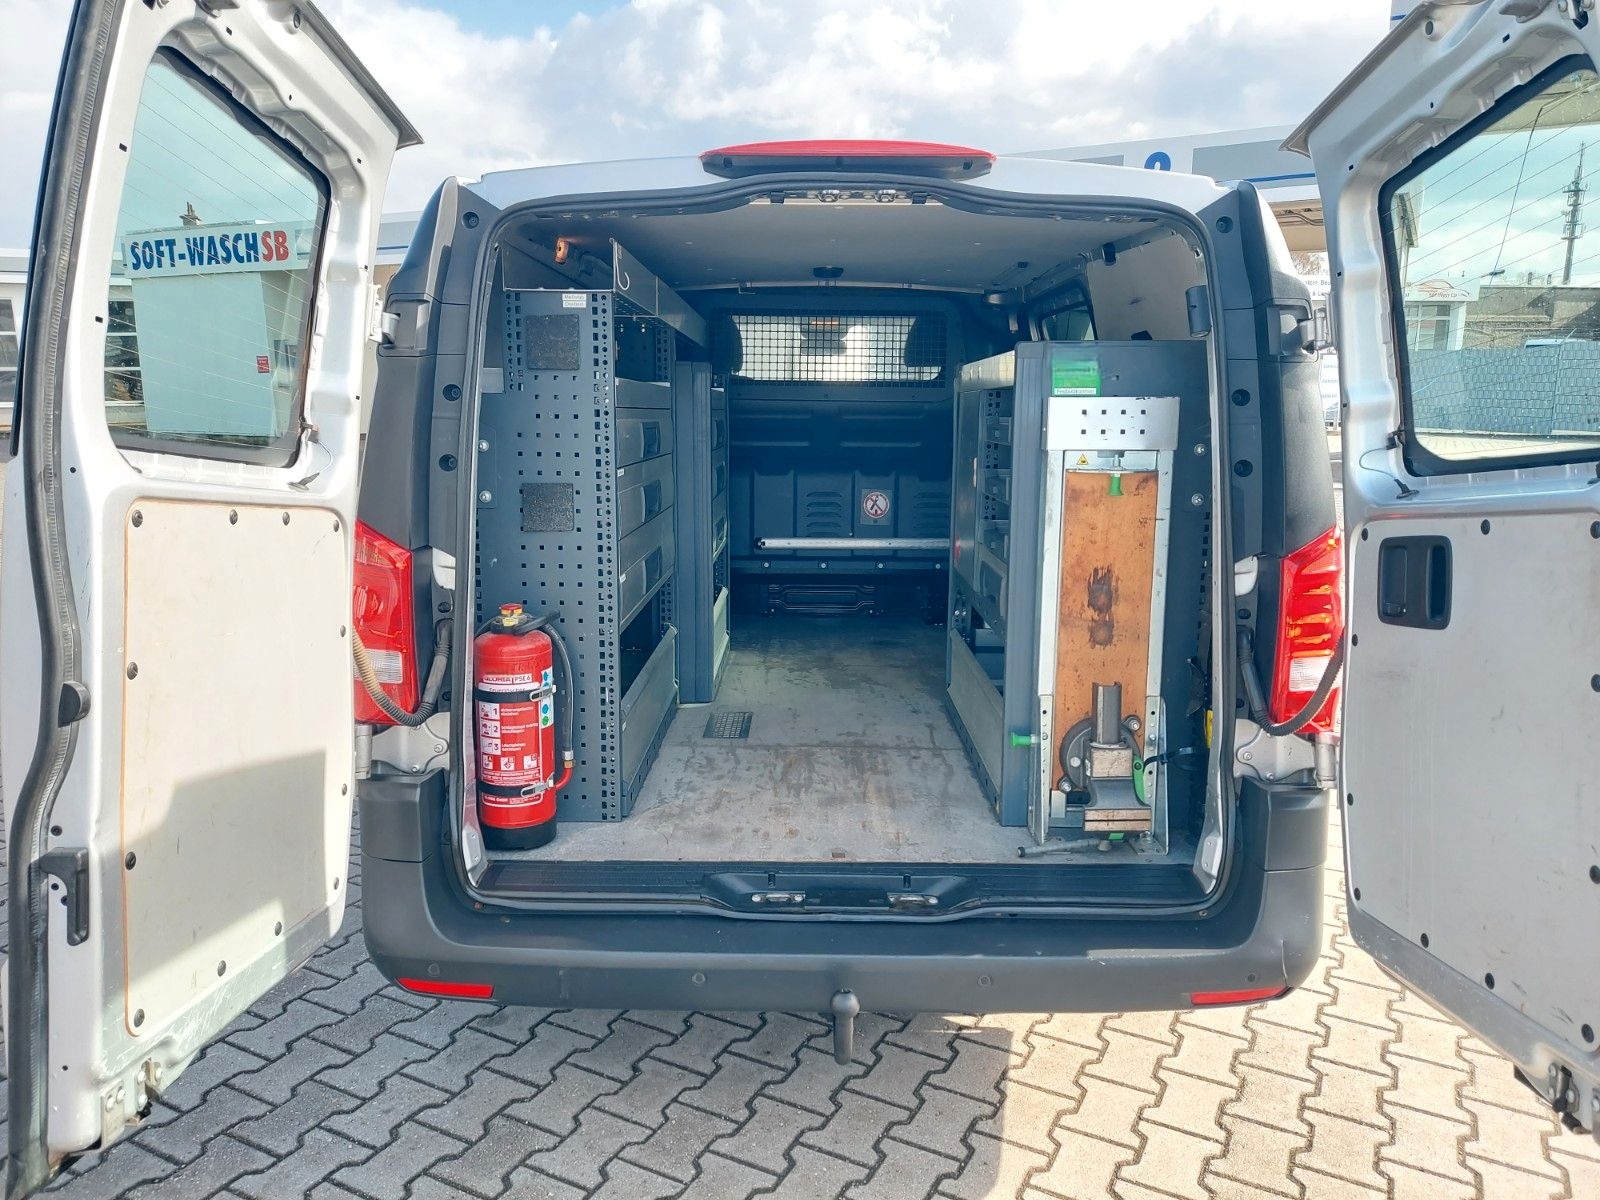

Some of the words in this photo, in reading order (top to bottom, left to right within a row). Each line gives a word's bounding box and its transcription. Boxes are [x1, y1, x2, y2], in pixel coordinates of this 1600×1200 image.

[131, 232, 260, 271] SOFT-WASCH
[261, 230, 290, 262] SB
[493, 743, 499, 751] 3
